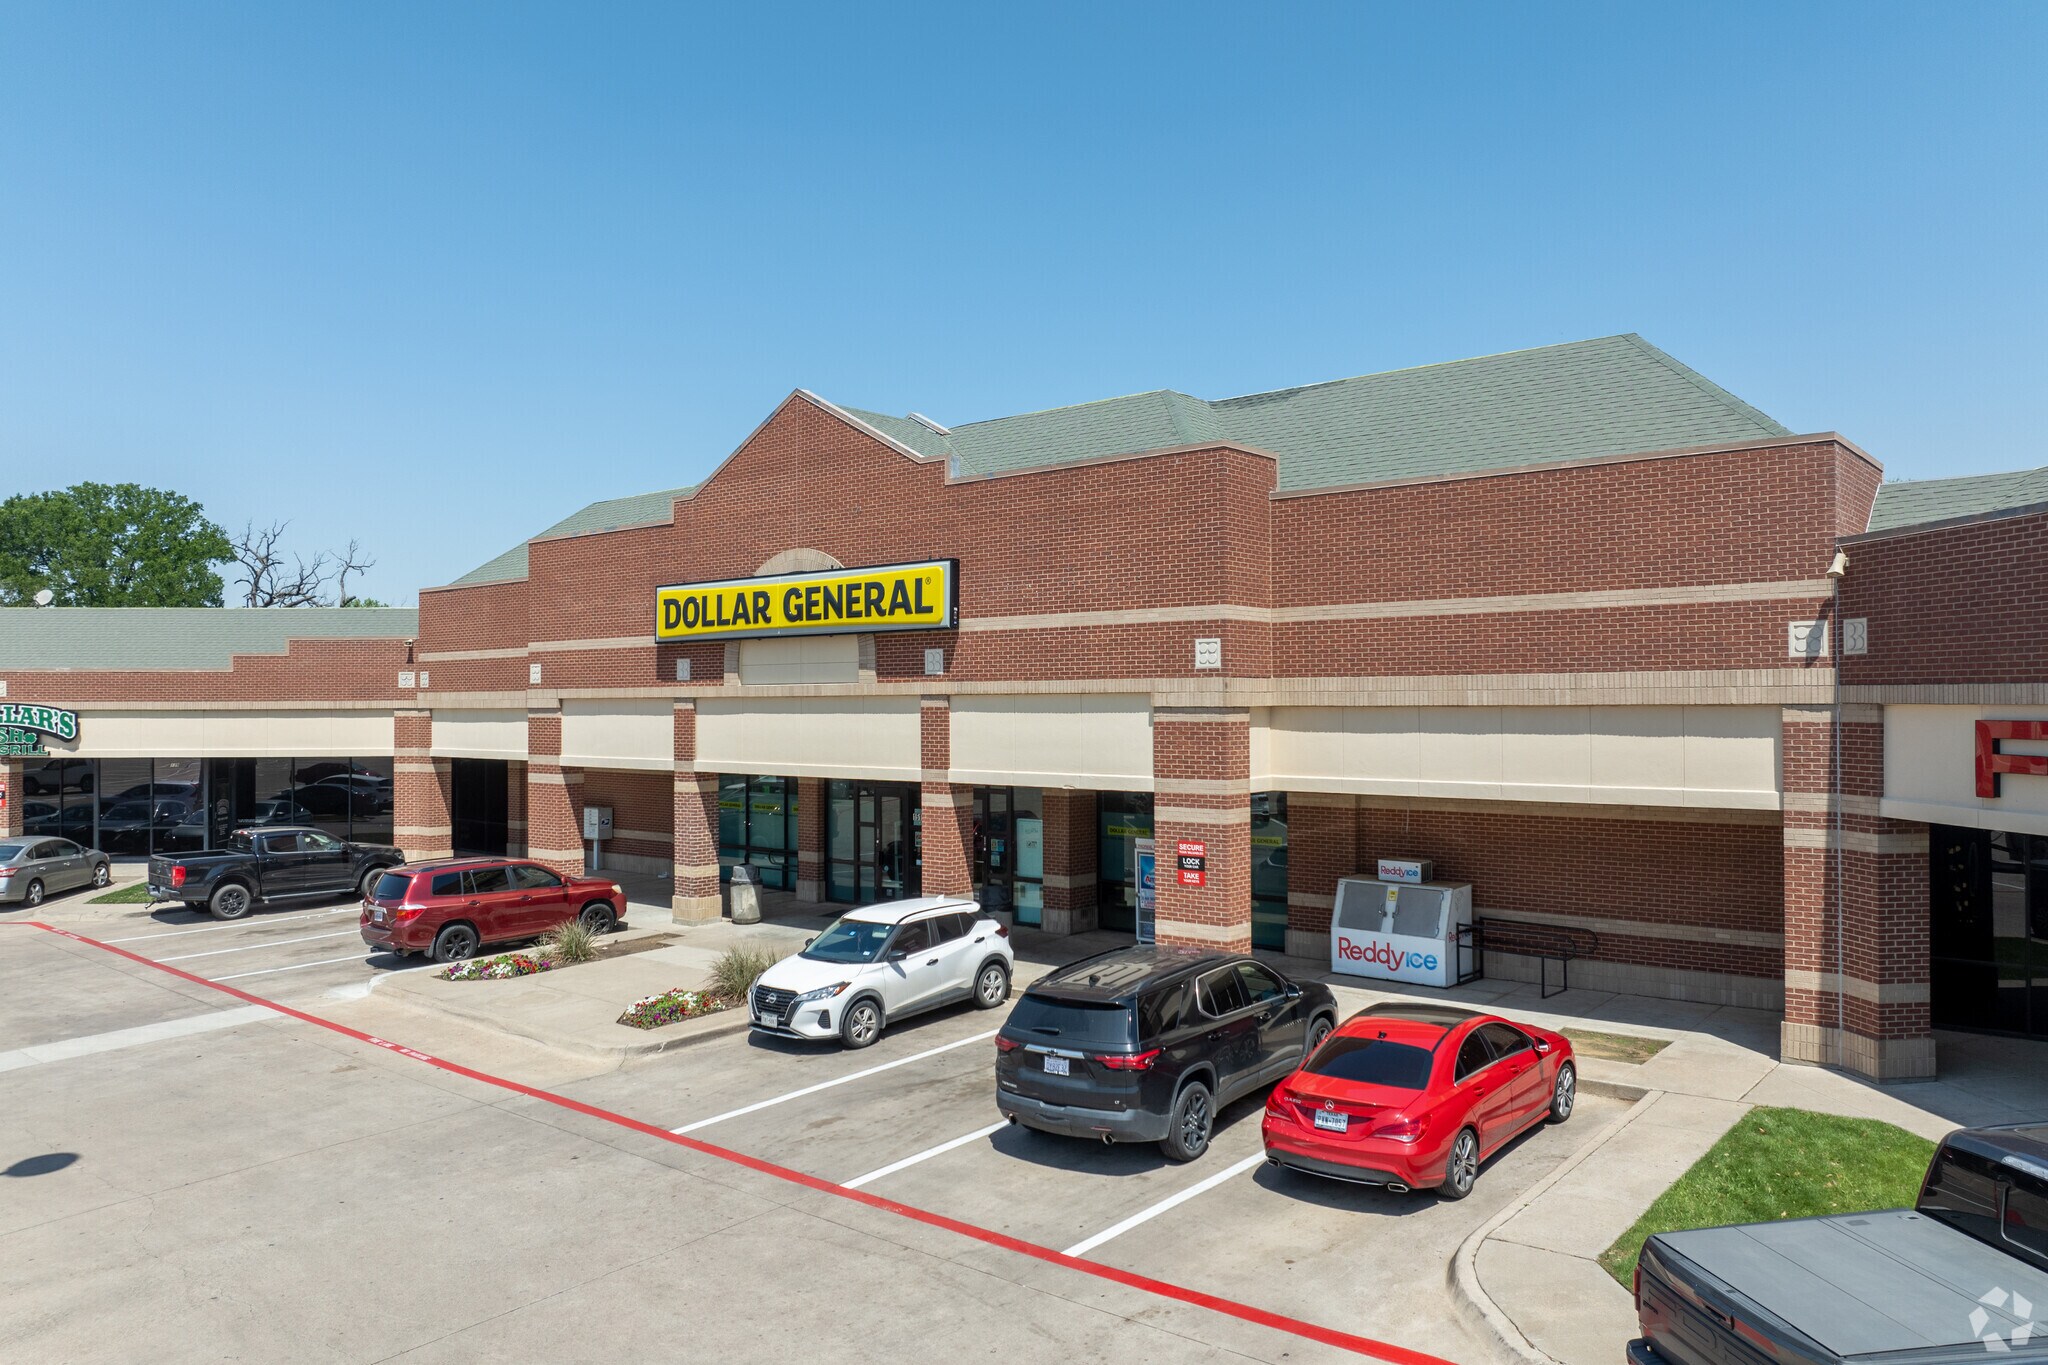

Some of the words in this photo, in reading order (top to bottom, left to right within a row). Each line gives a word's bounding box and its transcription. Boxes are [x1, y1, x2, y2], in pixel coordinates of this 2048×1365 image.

[663, 591, 771, 630] DOLLAR
[783, 577, 934, 623] GENERAL
[0, 705, 76, 739] LAR'S
[0, 745, 48, 756] GRILL
[1179, 843, 1204, 852] SECURE
[1182, 857, 1200, 866] LOCK
[1183, 872, 1200, 881] TAKE
